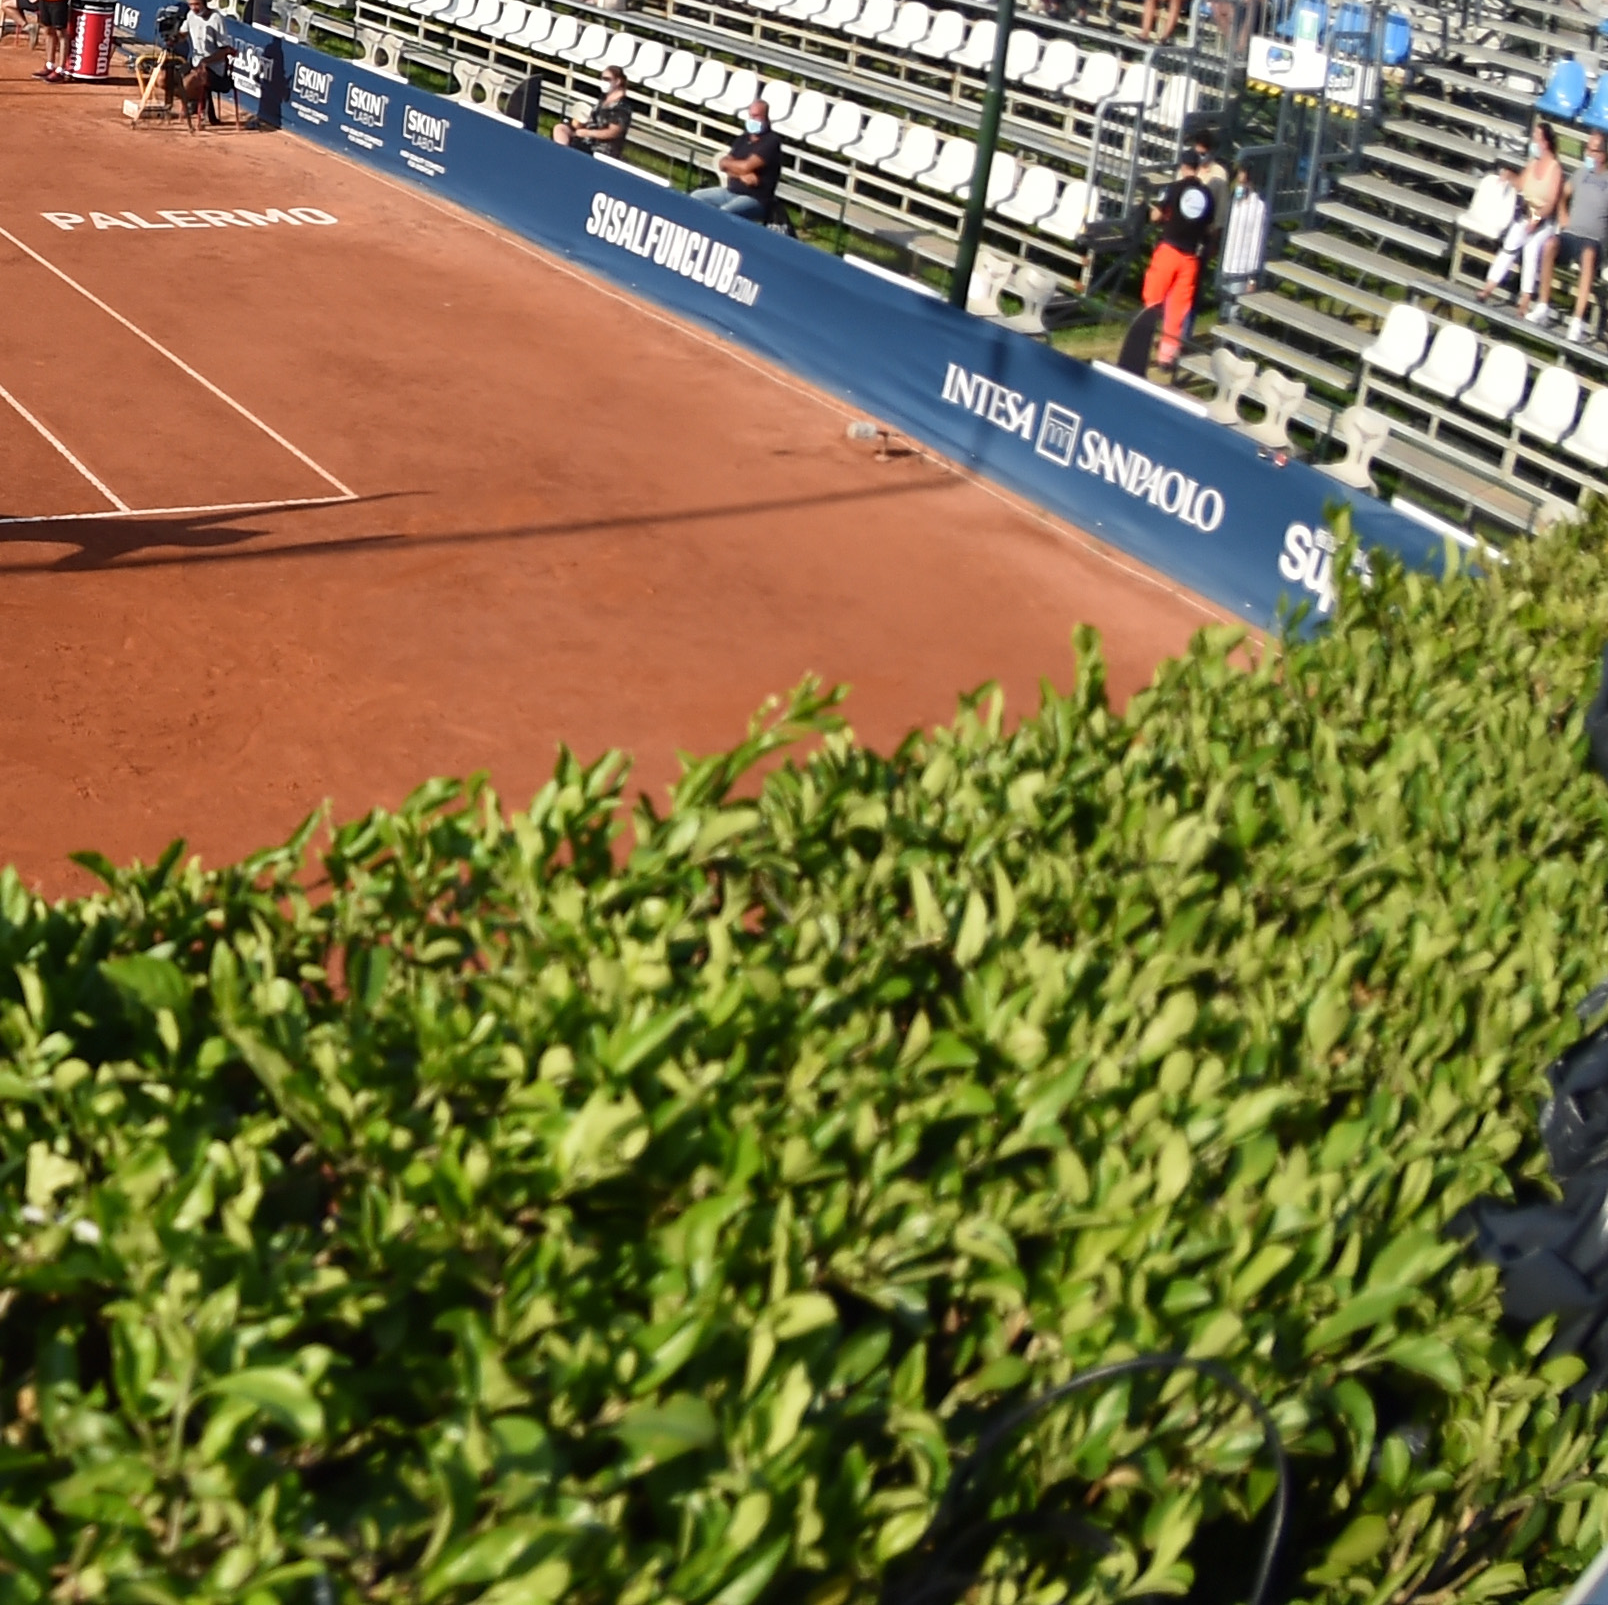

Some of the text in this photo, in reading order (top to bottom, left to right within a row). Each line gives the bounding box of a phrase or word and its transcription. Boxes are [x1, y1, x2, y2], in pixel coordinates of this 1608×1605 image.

[96, 17, 113, 75] Wilson
[297, 65, 327, 94] SKIN
[348, 87, 384, 117] SKIN
[407, 109, 442, 141] SKIN
[39, 206, 339, 231] PALERMO
[941, 362, 1225, 533] INTESA SANPAOLO
